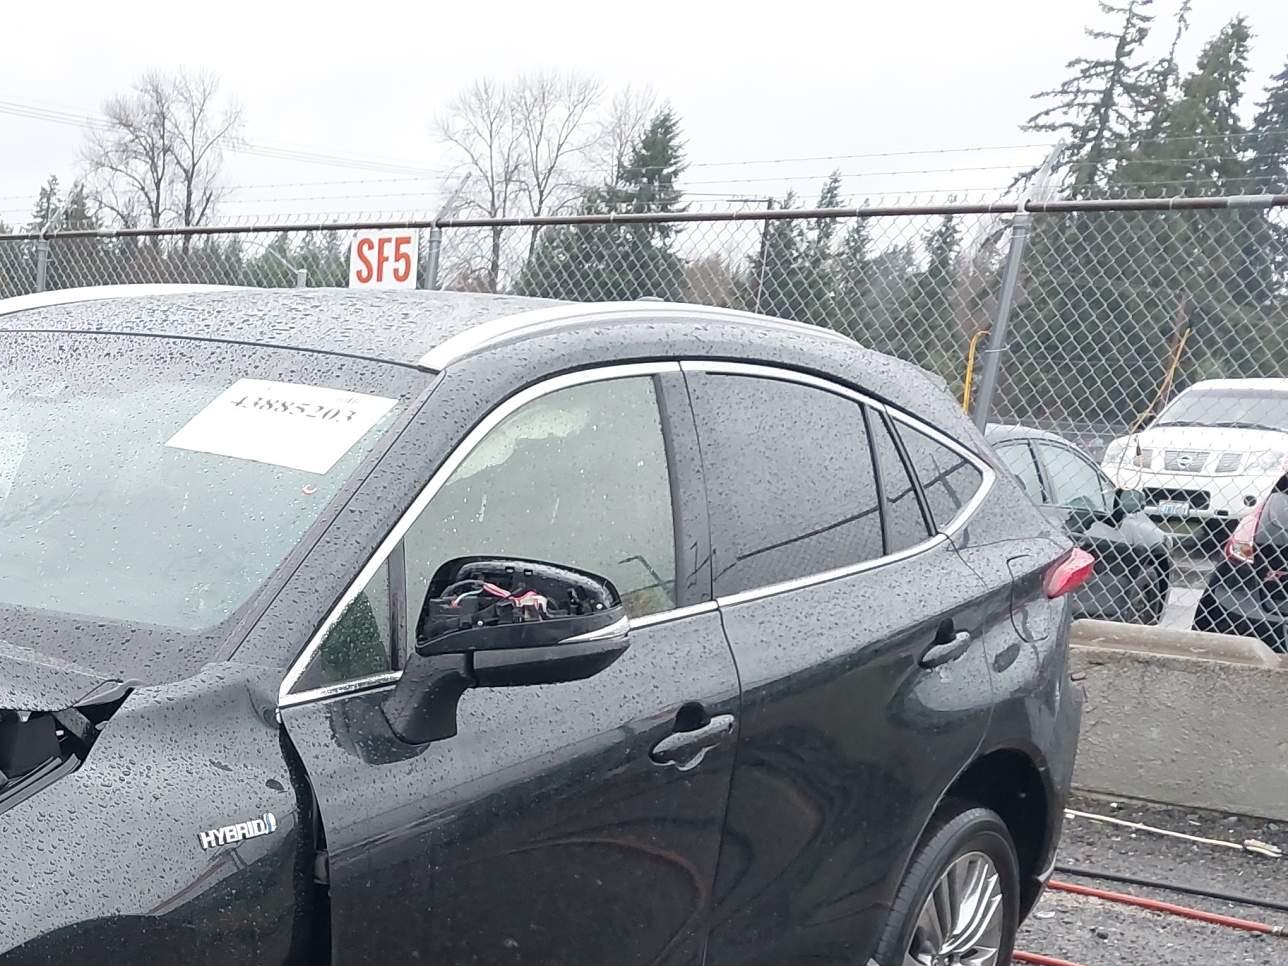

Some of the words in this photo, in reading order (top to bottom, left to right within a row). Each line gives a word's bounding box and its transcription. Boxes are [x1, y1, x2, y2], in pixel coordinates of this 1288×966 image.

[356, 236, 411, 283] SF5
[231, 395, 357, 423] 43885203
[199, 819, 267, 849] HYBRID
